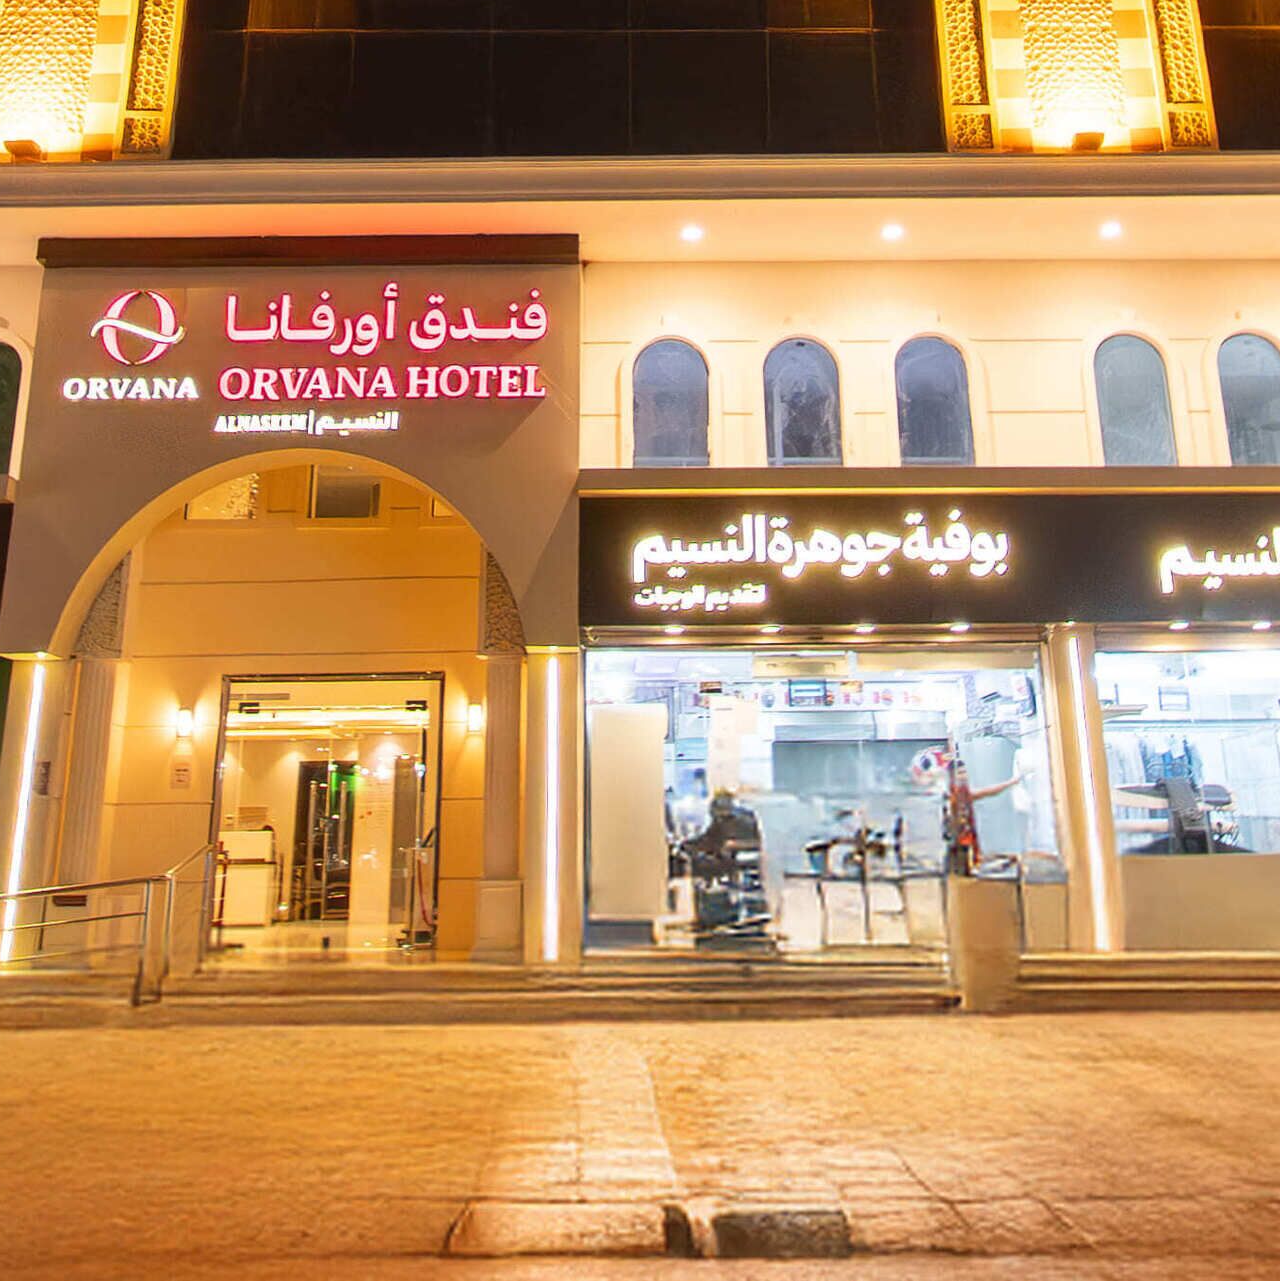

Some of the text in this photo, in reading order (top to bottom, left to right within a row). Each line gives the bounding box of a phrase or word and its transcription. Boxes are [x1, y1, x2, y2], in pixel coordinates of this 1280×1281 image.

[225, 281, 549, 357] فندق أورفانا
[62, 376, 200, 401] ORVANA
[218, 364, 547, 402] ORVANA HOTEL
[314, 410, 400, 436] النسيم
[633, 508, 1010, 584] بوفية جوهرة النسيم
